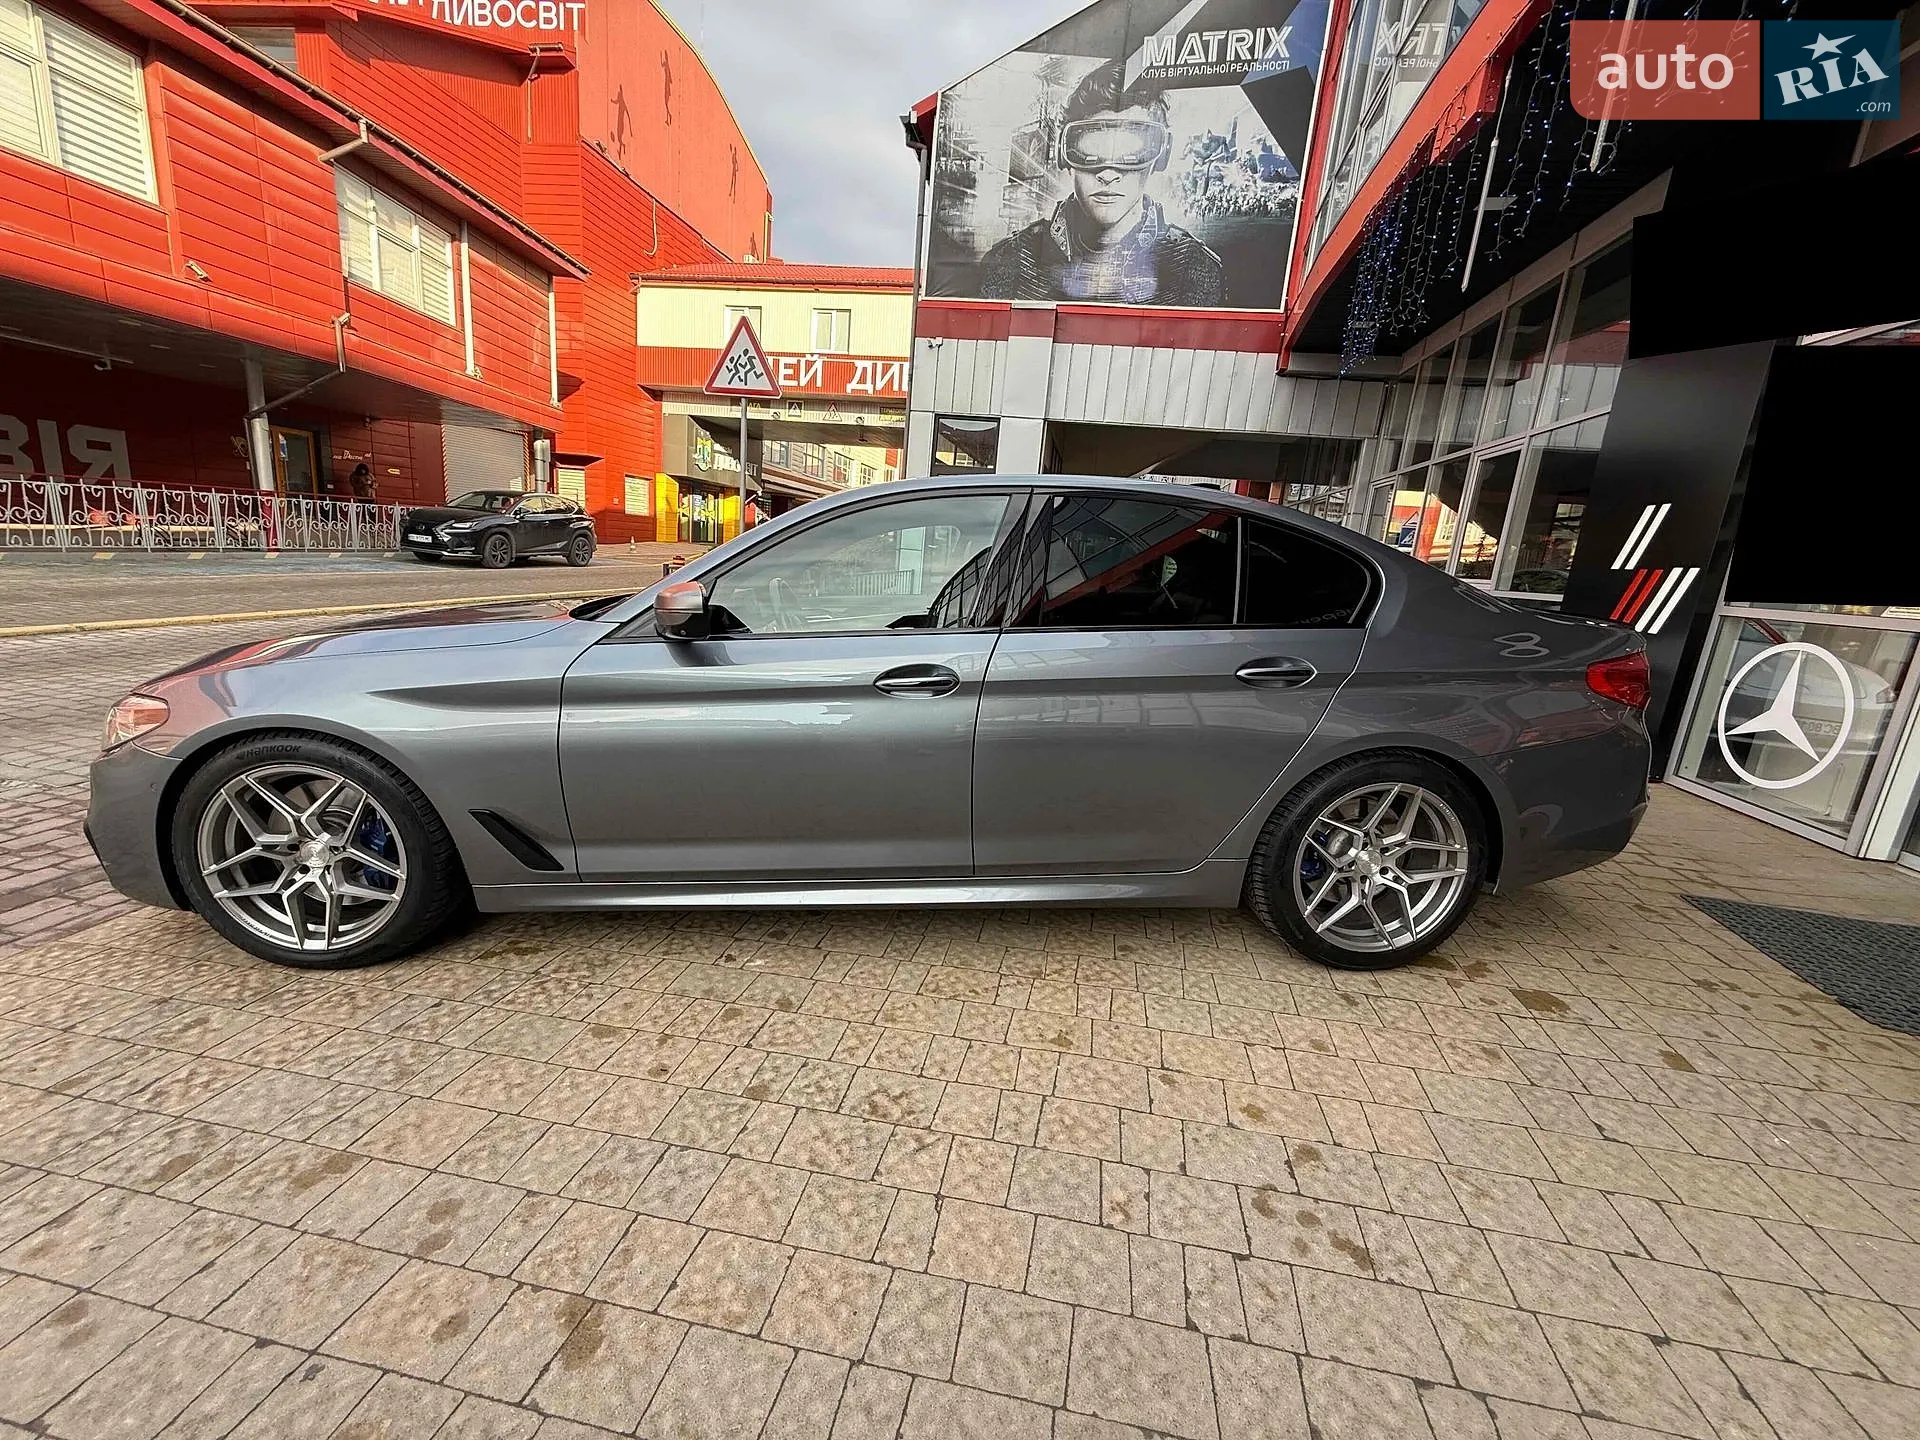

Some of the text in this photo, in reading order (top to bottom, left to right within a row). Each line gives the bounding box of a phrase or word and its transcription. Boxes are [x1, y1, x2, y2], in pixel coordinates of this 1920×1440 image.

[1142, 26, 1293, 67] MATRIX
[1141, 60, 1290, 79] КЛУБ ВІРТУАЛЬНОЇ РЕАЛЬНОСТІ
[767, 354, 823, 388] ЕЙ
